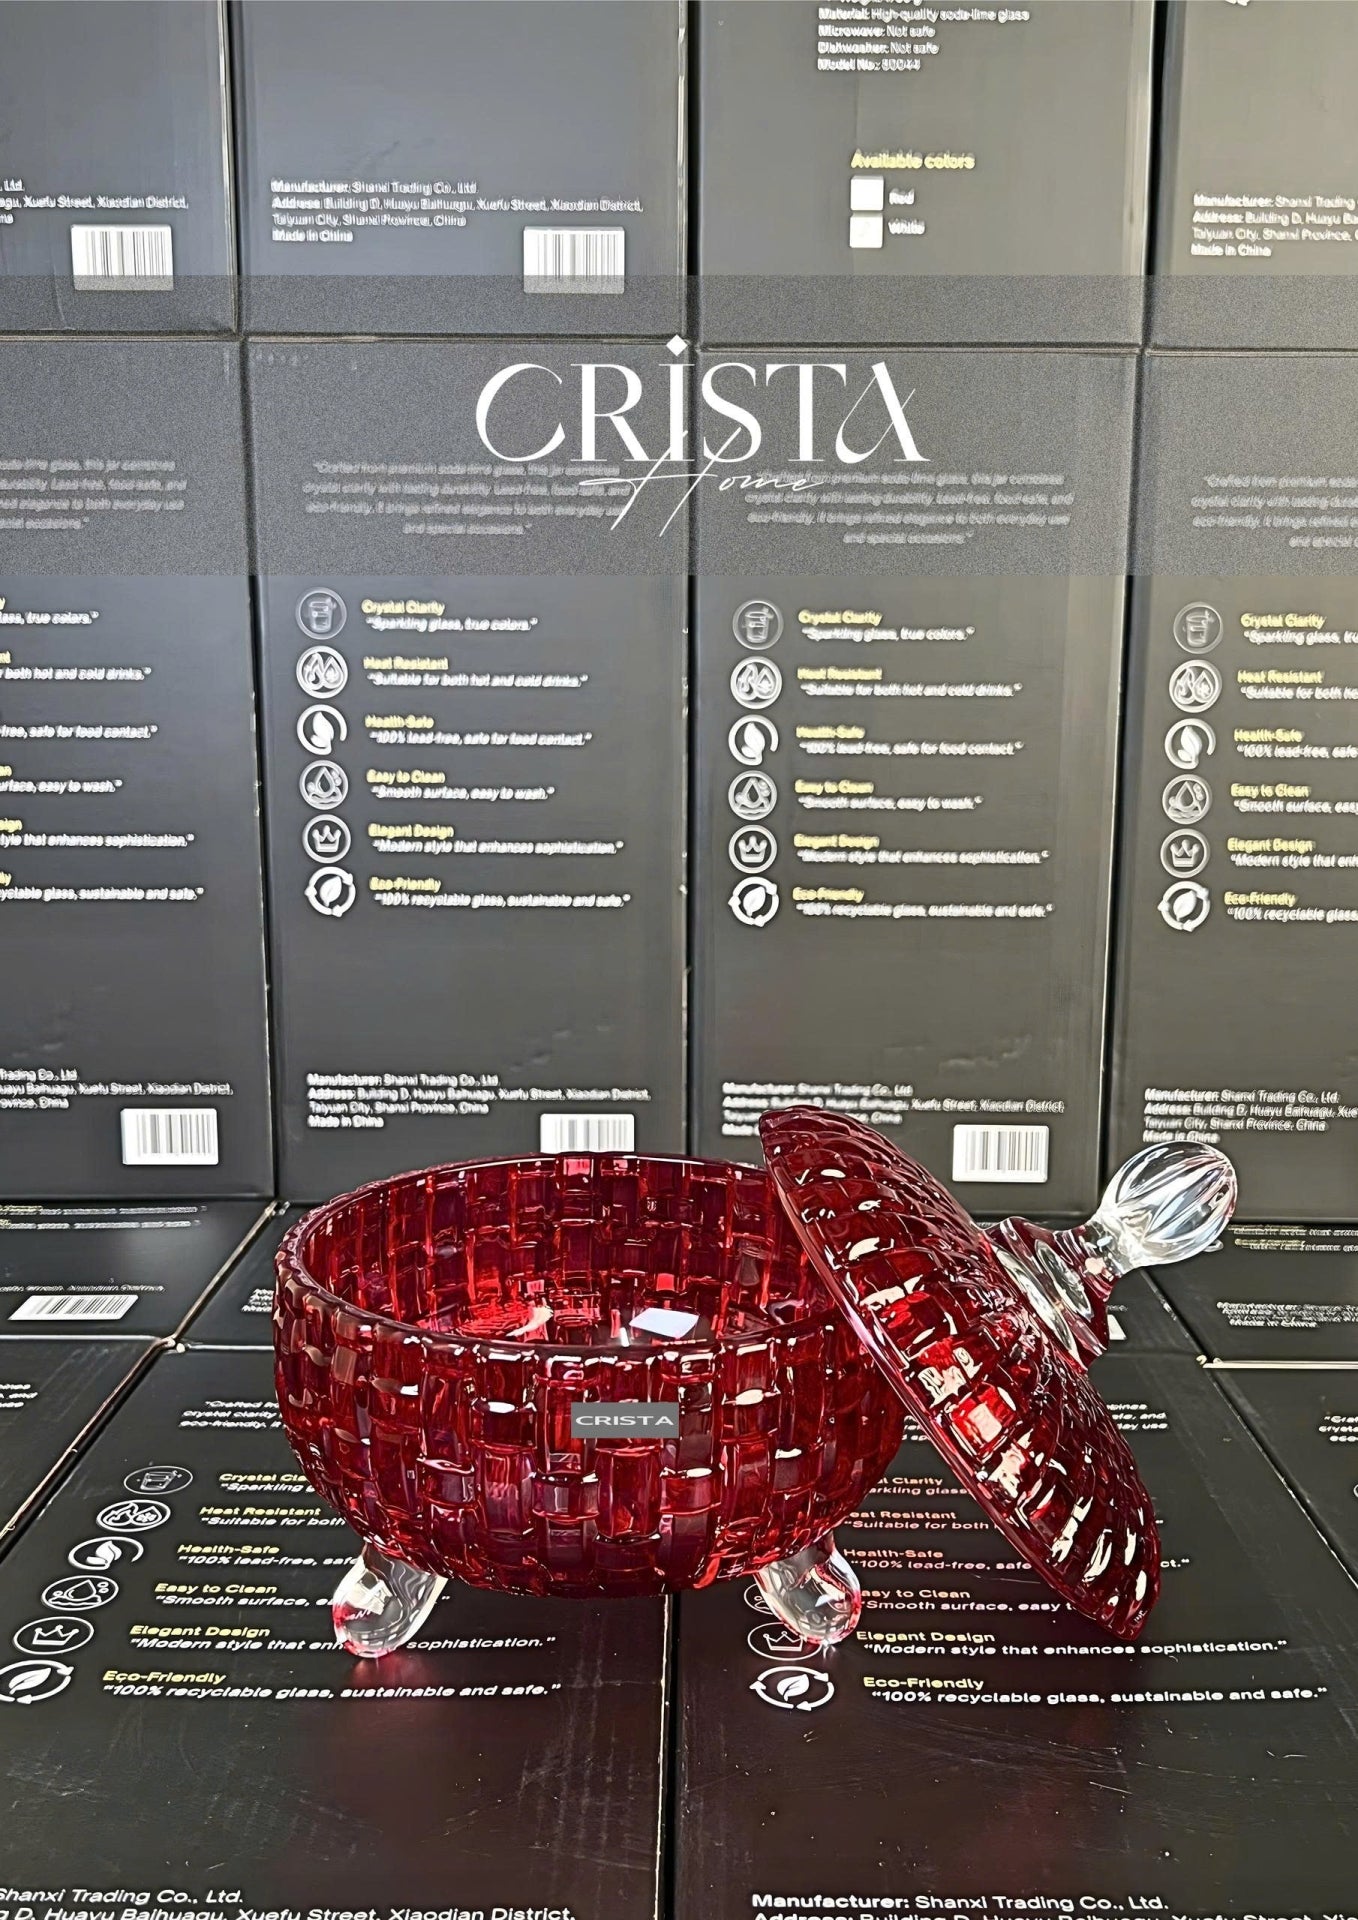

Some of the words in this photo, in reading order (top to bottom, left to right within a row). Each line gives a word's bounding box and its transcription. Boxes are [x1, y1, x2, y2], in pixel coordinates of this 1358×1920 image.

[851, 149, 922, 168] Available
[924, 150, 975, 169] colors
[1241, 613, 1283, 629] Crystal
[1285, 613, 1326, 630] Clarity
[1238, 670, 1265, 684] Heat
[1268, 670, 1324, 684] Resistant
[1234, 728, 1304, 742] Health-Safe
[38, 780, 67, 794] easy
[1231, 783, 1258, 798] Easy
[1261, 784, 1273, 797] to
[1275, 784, 1311, 797] Clean
[1227, 838, 1271, 852] Elegant
[1273, 838, 1315, 854] Design
[1224, 892, 1296, 907] Eco-Friendly
[219, 1473, 276, 1482] Crystal
[892, 1477, 943, 1485] Clarity
[199, 1507, 240, 1515] Heat
[243, 1507, 321, 1516] Resistant
[880, 1511, 957, 1519] Resistant
[924, 1521, 947, 1529] for
[952, 1521, 990, 1529] both
[177, 1545, 280, 1554] Health-Safe
[844, 1549, 944, 1558] Health-Safe
[234, 1556, 317, 1566] lead-free,
[907, 1561, 990, 1570] lead-free,
[996, 1562, 1032, 1570] safe
[154, 1583, 198, 1594] Easy
[203, 1584, 220, 1593] to
[225, 1584, 277, 1594] Clean
[861, 1591, 890, 1599] asy
[896, 1590, 914, 1599] to
[918, 1590, 970, 1599] Clean
[238, 1597, 310, 1606] surface,
[940, 1602, 1013, 1611] surface,
[1018, 1603, 1060, 1612] easy
[130, 1625, 202, 1637] Elegant
[205, 1626, 270, 1638] Design
[856, 1631, 926, 1642] Elegant
[931, 1632, 996, 1643] Design
[215, 1640, 262, 1651] style
[267, 1640, 306, 1650] that
[950, 1646, 997, 1656] style
[1002, 1645, 1038, 1655] that
[1044, 1645, 1135, 1655] enhances
[103, 1671, 226, 1685] Eco-Friendly
[863, 1677, 984, 1690] Eco-Friendly
[166, 1686, 272, 1699] recyclable
[275, 1687, 334, 1699] glass,
[341, 1686, 455, 1698] sustainable
[460, 1685, 498, 1697] and
[937, 1692, 1042, 1704] recyclable
[1047, 1693, 1105, 1705] glass,
[1111, 1691, 1223, 1702] sustainable
[1230, 1690, 1265, 1700] and
[0, 1888, 65, 1902] Shanxi
[71, 1888, 150, 1905] Trading
[156, 1890, 198, 1904] Co.,
[206, 1890, 243, 1903] Ltd.
[752, 1894, 910, 1908] Manufacturer:
[915, 1895, 987, 1909] Shanxi
[992, 1896, 1074, 1911] Trading
[1079, 1896, 1124, 1910] Co.,
[1128, 1896, 1169, 1910] Ltd.
